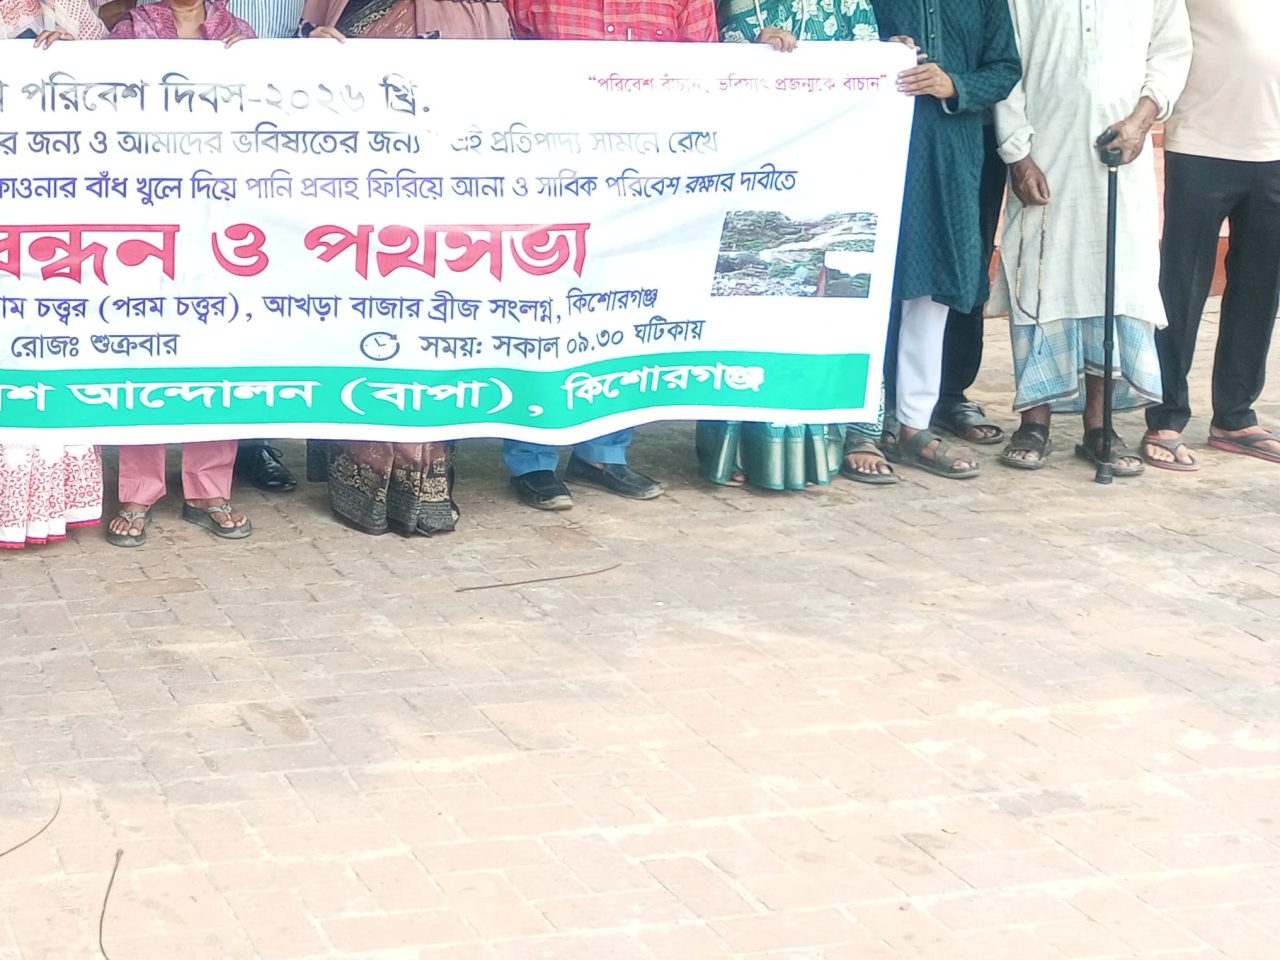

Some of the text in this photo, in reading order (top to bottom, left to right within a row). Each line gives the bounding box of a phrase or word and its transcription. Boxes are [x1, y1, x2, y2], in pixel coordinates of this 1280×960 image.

[21, 71, 150, 112] পরিবেশ
[27, 131, 82, 155] জন্য
[89, 130, 108, 155] ও
[117, 131, 223, 155] আমাদের
[231, 121, 360, 155] ভবিষ্যতের
[490, 122, 582, 155] প্রতিপাদ্য
[588, 131, 661, 155] সামনে
[668, 131, 718, 154] রেখে
[85, 171, 128, 200] বাঁধ
[135, 177, 183, 206] খুলে
[191, 169, 237, 200] দিয়ে
[245, 169, 293, 199] পানি
[300, 177, 360, 200] প্রবাহ
[367, 168, 444, 199] ফিরিয়ে
[450, 176, 505, 198] আনা
[511, 176, 529, 198] ও
[536, 168, 598, 198] সার্বিক
[605, 168, 682, 197] পরিবেশ
[684, 172, 736, 194] রক্ষার
[740, 163, 798, 192] দাবীতে
[211, 222, 269, 275] ও
[304, 222, 591, 283] পথসভা
[35, 297, 89, 326] চত্ত্বর
[98, 295, 166, 323] (পরম
[261, 294, 342, 322] আখড়া
[349, 295, 424, 321] বাজার
[427, 290, 482, 323] ব্রীজ
[489, 297, 561, 325] সংলগ্ন,
[567, 286, 659, 316] কিশোরগঞ্জ
[90, 332, 181, 358] শুক্রবার
[492, 335, 560, 360] সকাল
[566, 331, 624, 356] ০৯.৩০
[633, 315, 707, 344] ঘটিকায়
[67, 379, 322, 411] আন্দোলন
[561, 362, 766, 410] কিশোরগঞ্জ
